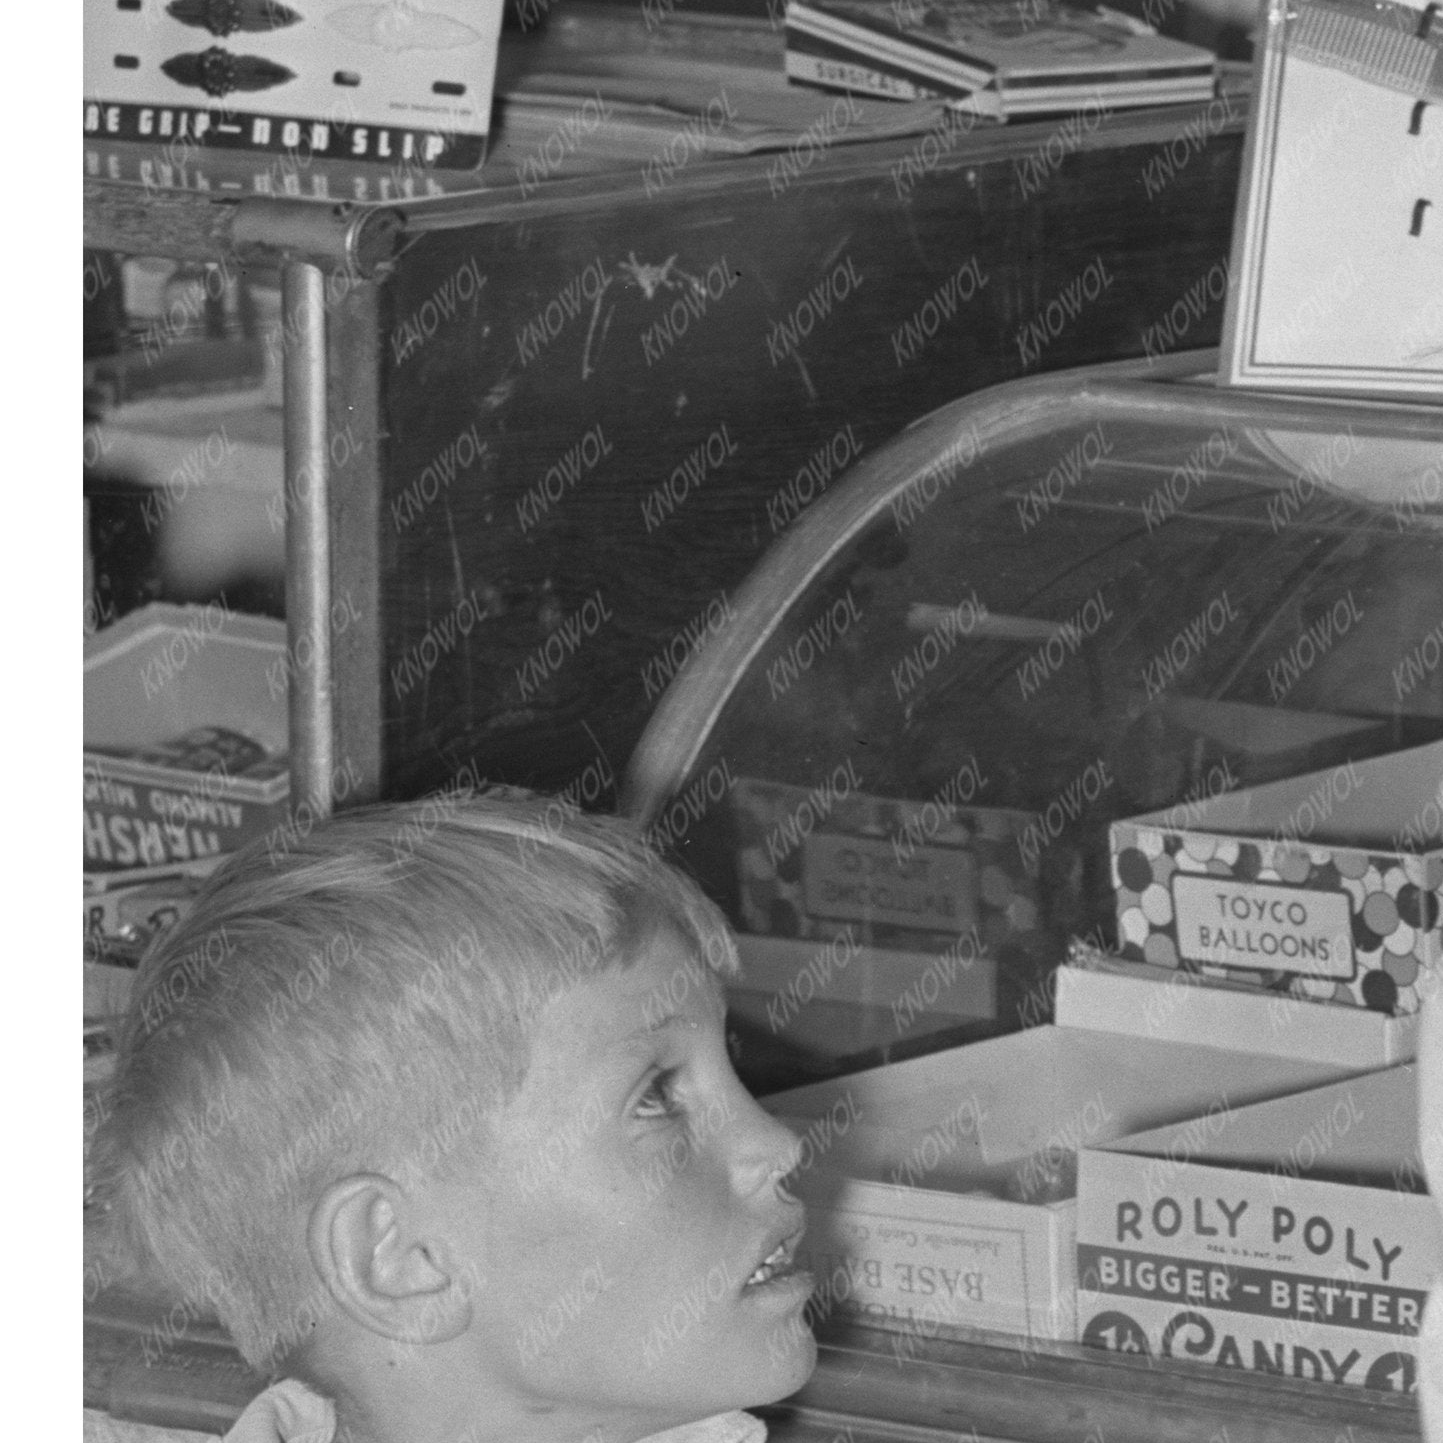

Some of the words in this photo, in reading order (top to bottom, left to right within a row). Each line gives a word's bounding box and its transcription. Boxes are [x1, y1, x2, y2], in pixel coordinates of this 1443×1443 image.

[138, 108, 211, 138] GRIP
[252, 118, 330, 151] NON
[352, 128, 446, 162] SLIP
[1216, 893, 1307, 927] TOYCO
[1198, 925, 1331, 961] BALLOONS
[1117, 1196, 1248, 1243] ROLY
[1272, 1205, 1403, 1282] POLY
[1098, 1255, 1230, 1302] BIGGER
[1270, 1281, 1418, 1329] BETTER
